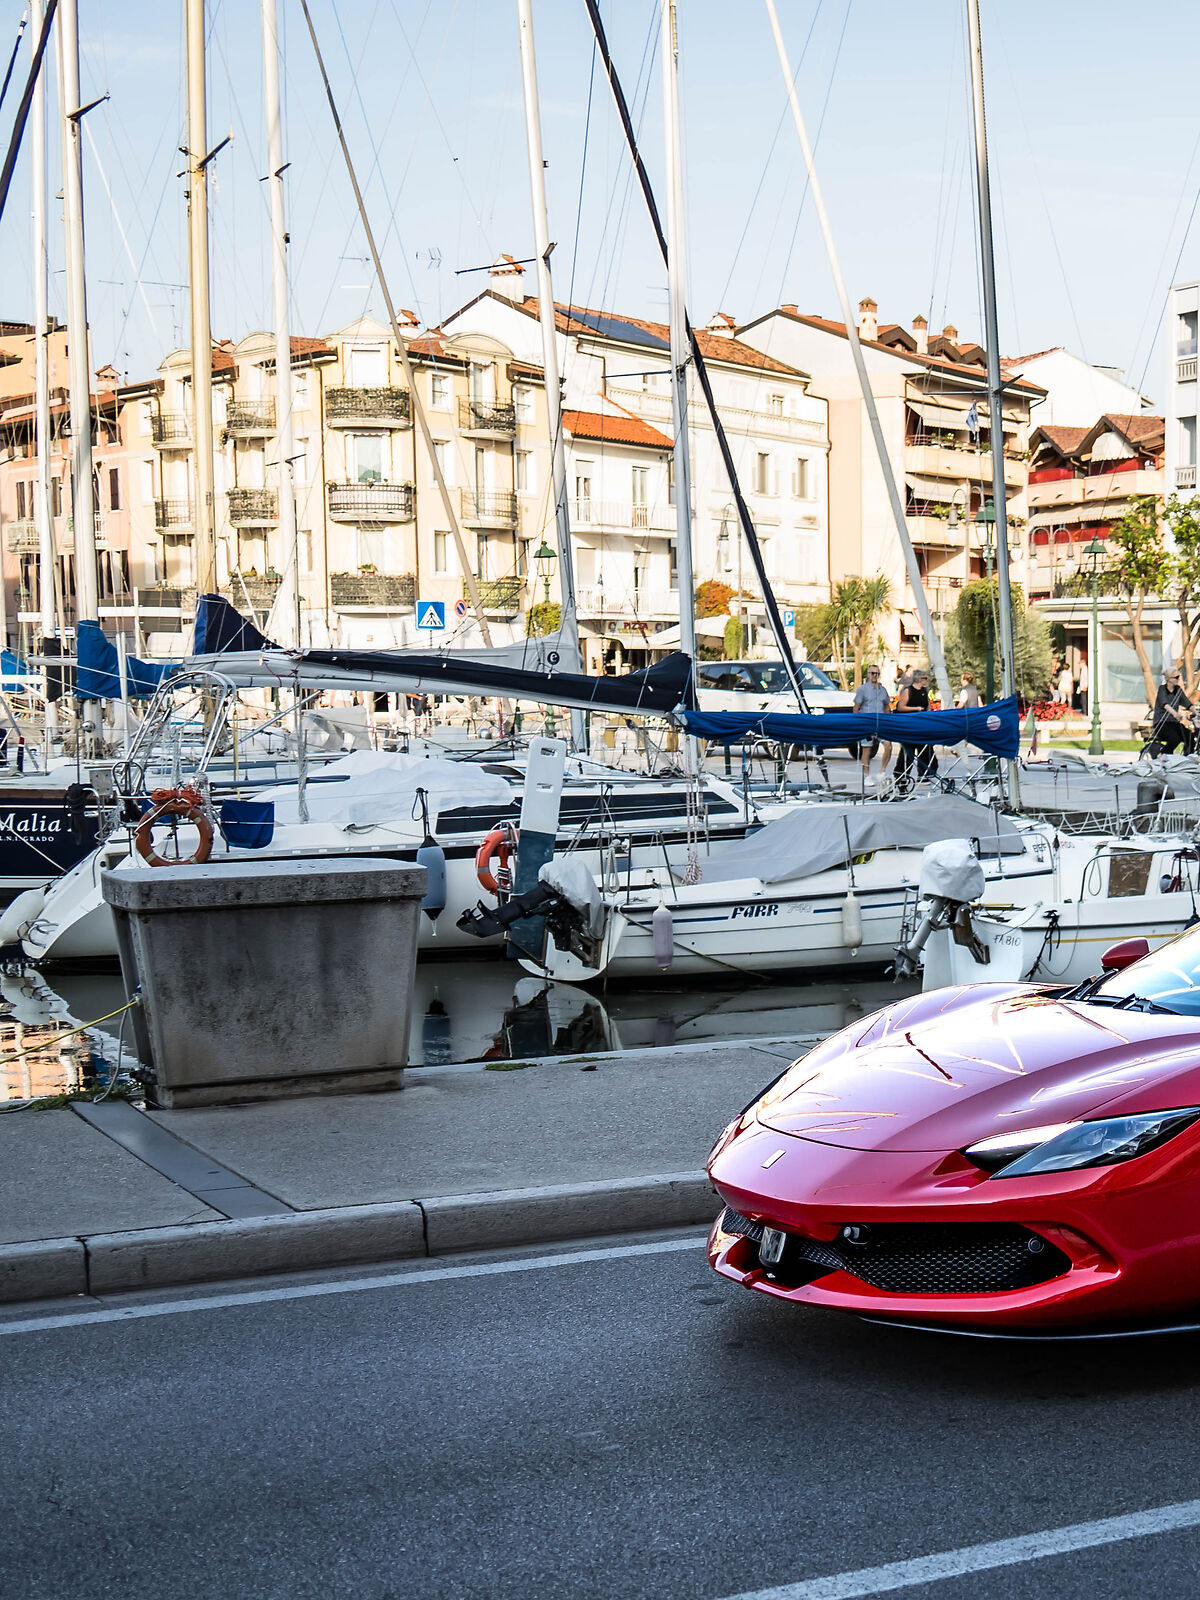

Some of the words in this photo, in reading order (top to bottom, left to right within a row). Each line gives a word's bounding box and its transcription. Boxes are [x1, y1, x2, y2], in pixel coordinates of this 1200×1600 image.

[785, 611, 793, 625] P
[731, 904, 779, 919] FARR
[993, 934, 1021, 946] FABIO
